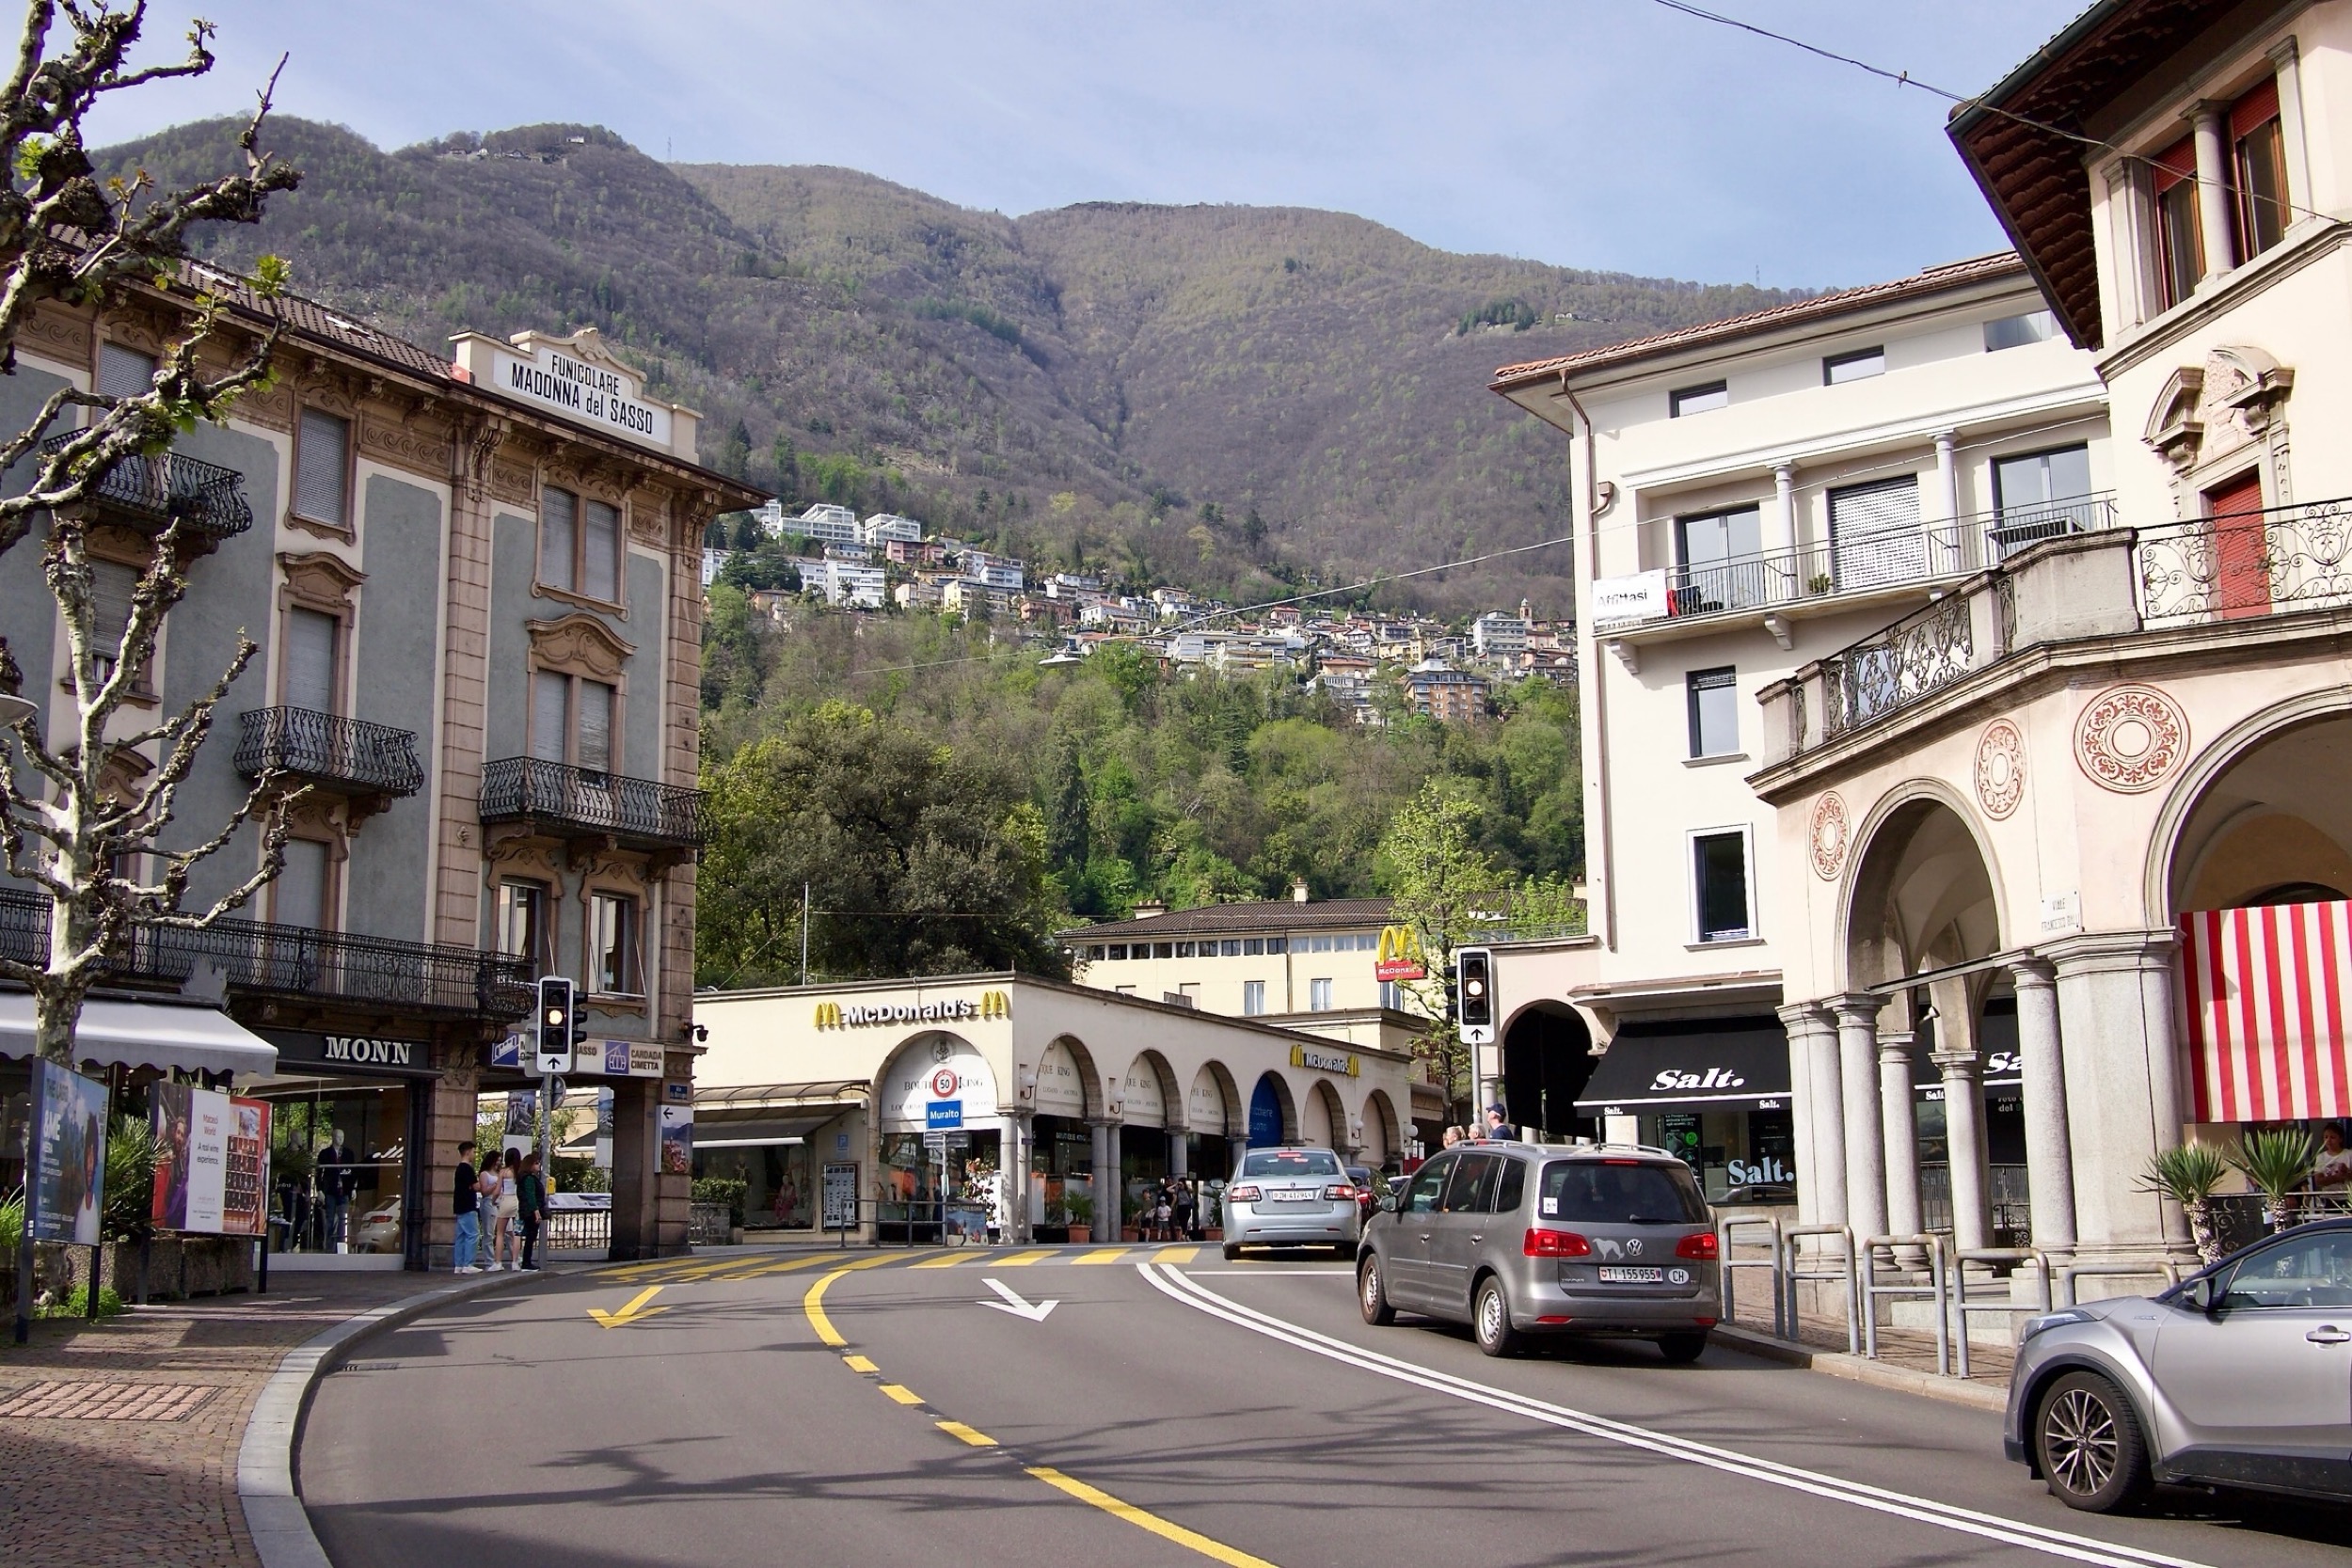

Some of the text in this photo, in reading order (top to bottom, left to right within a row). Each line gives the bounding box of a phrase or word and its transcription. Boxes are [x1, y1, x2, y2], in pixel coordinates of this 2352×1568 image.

[551, 354, 620, 397] FUNICOLARE
[511, 361, 653, 435] MADONNA del SASSO
[848, 998, 973, 1024] McDonald's
[325, 1036, 412, 1065] MONN
[577, 1045, 598, 1056] ASSO
[630, 1049, 662, 1061] CARDADA
[630, 1060, 660, 1070] CIMETTA
[1305, 1053, 1350, 1074] McDonald's
[940, 1079, 950, 1089] 50
[1649, 1067, 1745, 1091] Salt.
[930, 1109, 960, 1121] Muralto
[1727, 1156, 1795, 1186] Salt.
[1672, 1270, 1685, 1283] CH
